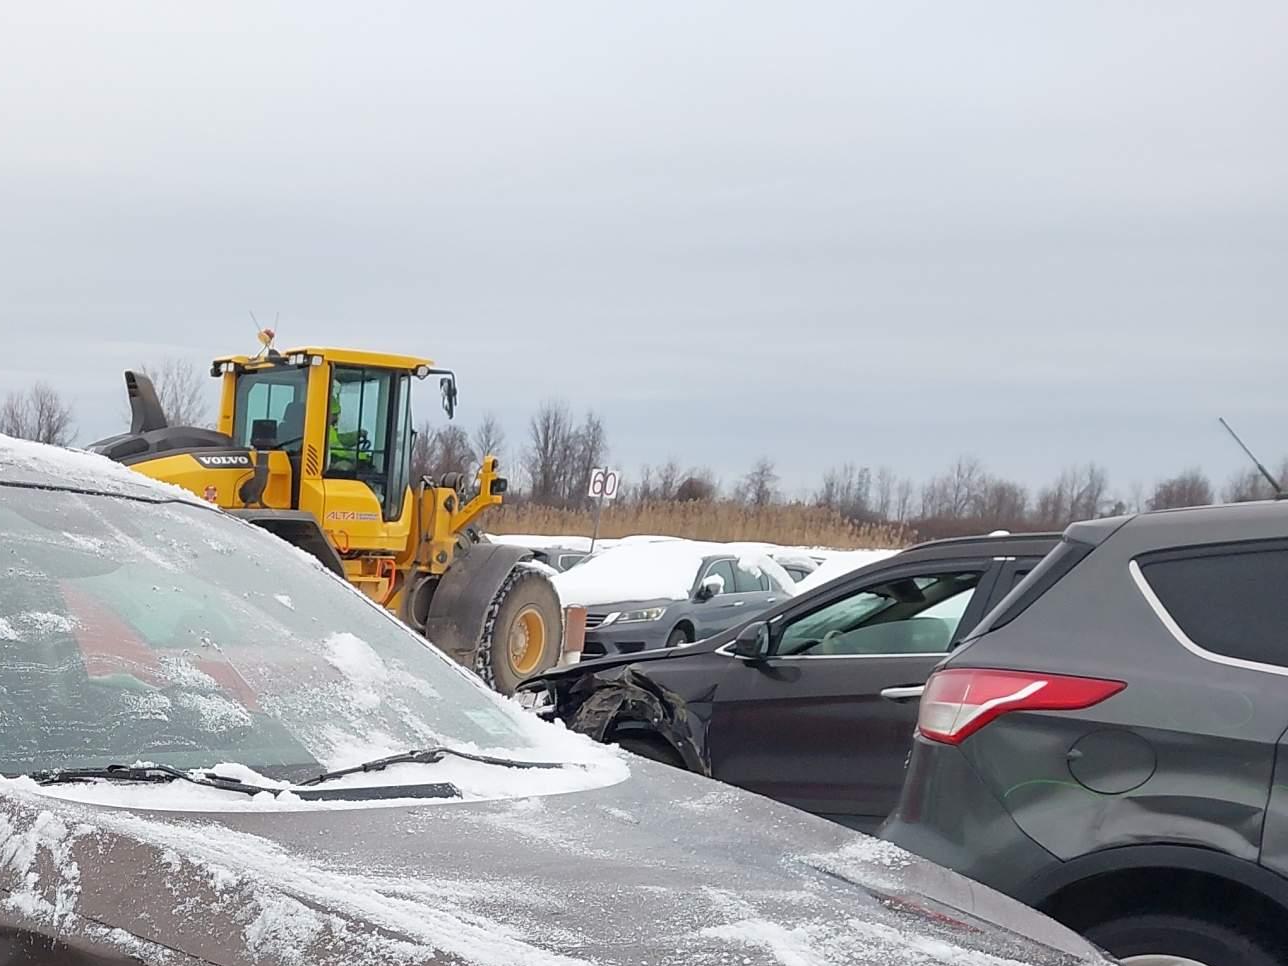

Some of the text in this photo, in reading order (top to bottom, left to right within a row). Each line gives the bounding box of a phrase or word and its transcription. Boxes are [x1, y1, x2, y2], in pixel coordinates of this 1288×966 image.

[199, 456, 249, 465] VOLVO
[592, 471, 617, 496] 60
[326, 511, 355, 520] ALTA
